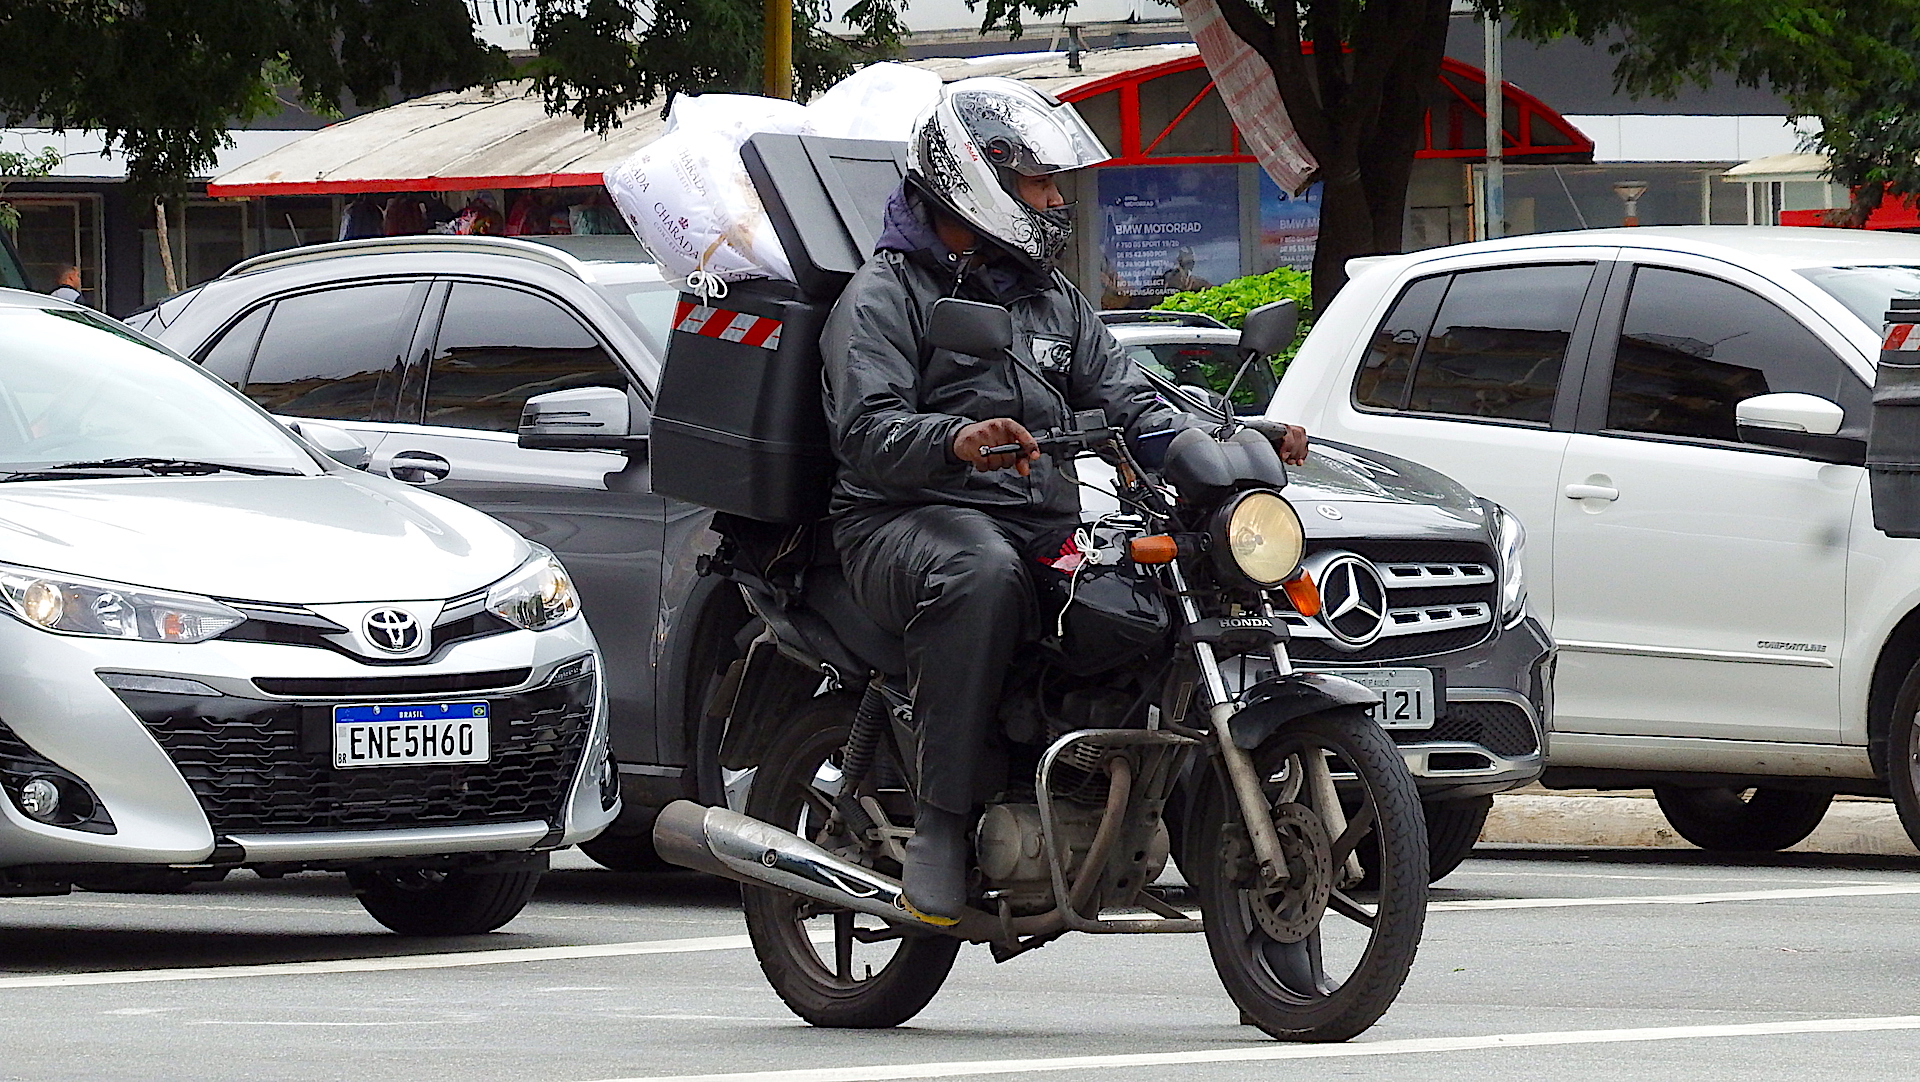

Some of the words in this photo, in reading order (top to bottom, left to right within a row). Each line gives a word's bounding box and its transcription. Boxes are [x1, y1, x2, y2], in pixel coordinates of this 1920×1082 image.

[1115, 224, 1141, 235] BMW
[1143, 222, 1202, 234] MOTORRAD
[1279, 219, 1305, 230] BMW
[653, 202, 700, 260] CHARADA
[653, 221, 685, 257] CONCEITO
[1143, 279, 1164, 287] SELECT
[1219, 618, 1273, 628] HONDA
[1757, 640, 1827, 653] COMFORTLINE
[398, 711, 424, 719] BRASIL
[350, 723, 473, 760] ENE5H60
[338, 753, 347, 764] BR
